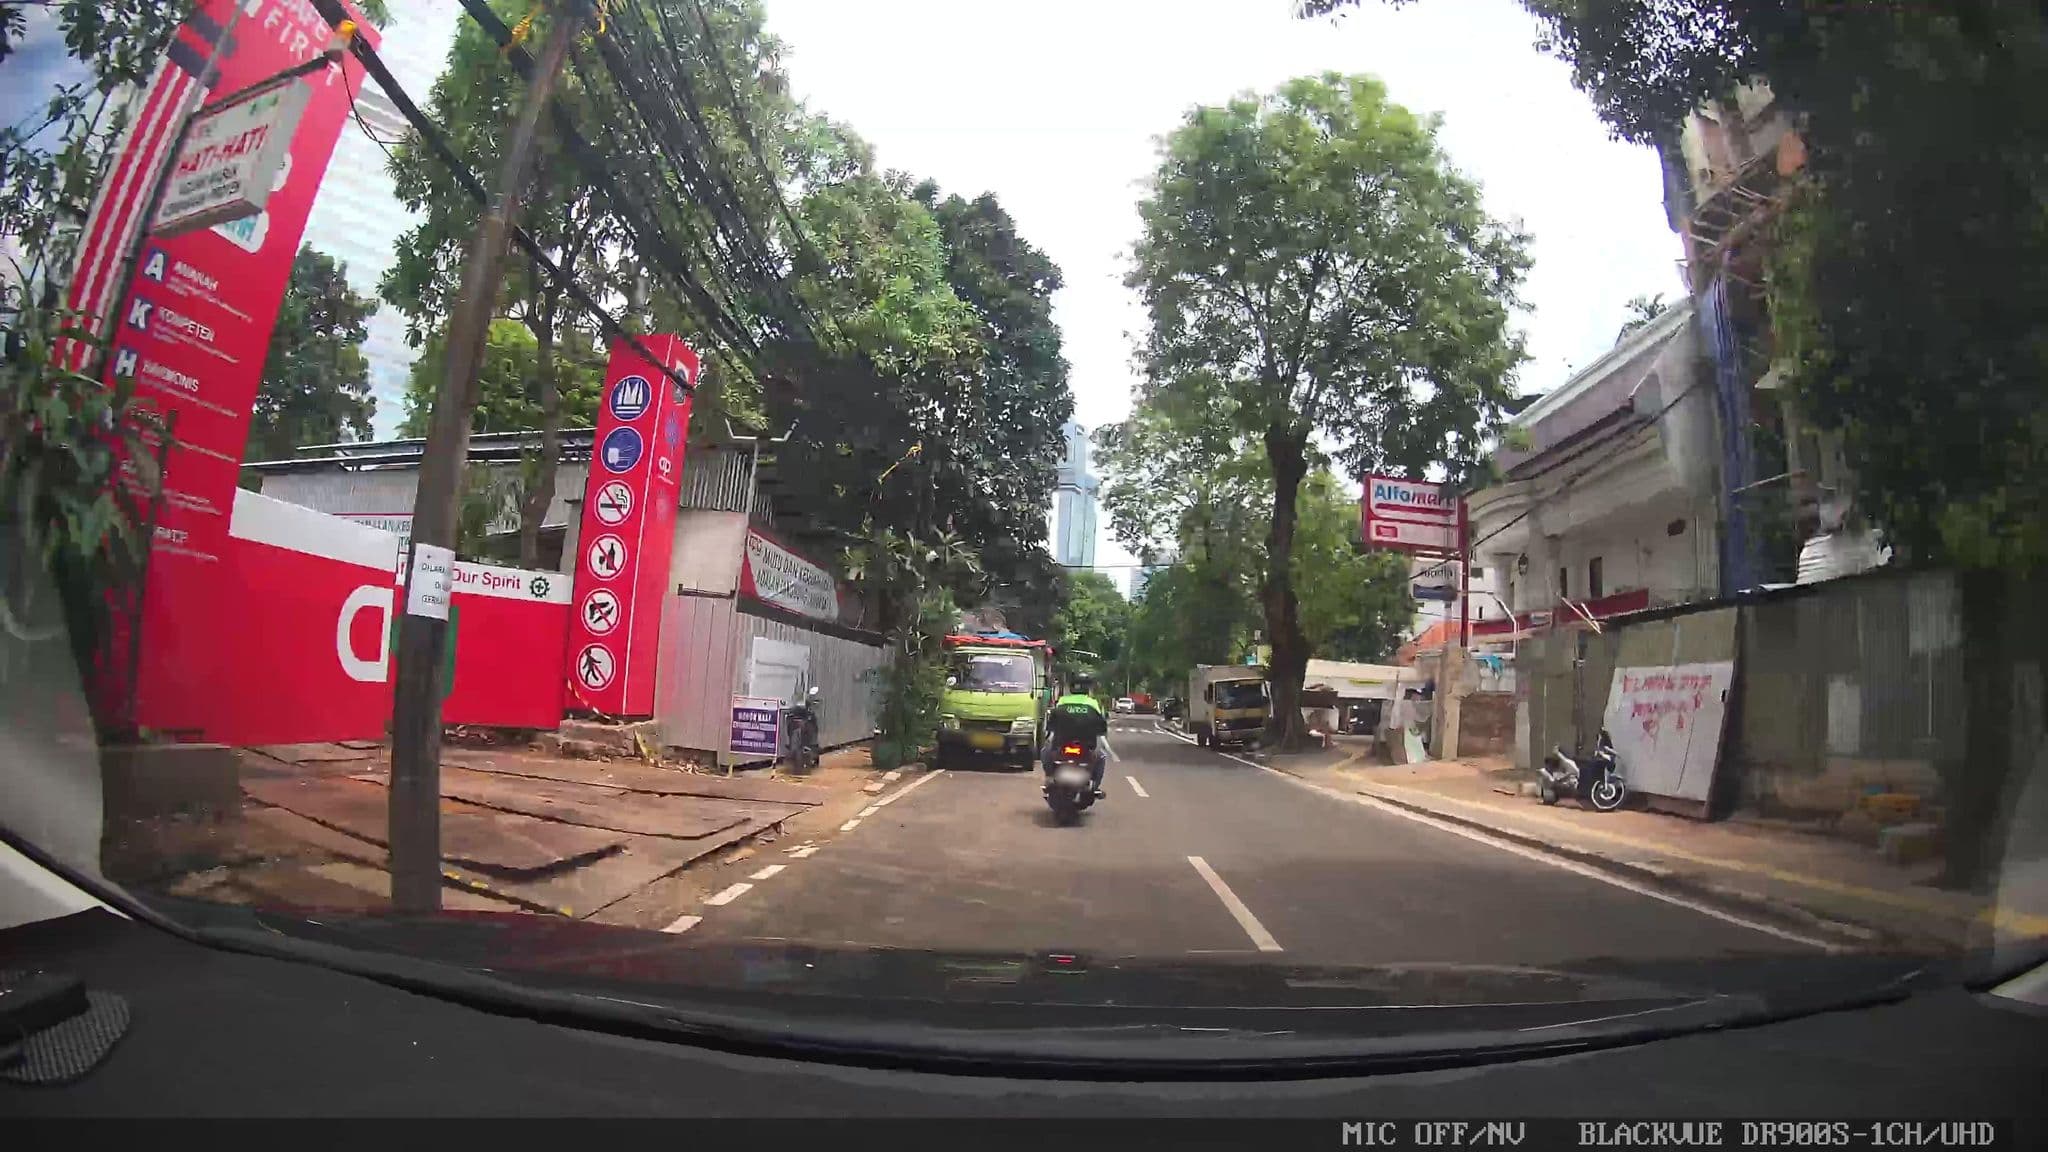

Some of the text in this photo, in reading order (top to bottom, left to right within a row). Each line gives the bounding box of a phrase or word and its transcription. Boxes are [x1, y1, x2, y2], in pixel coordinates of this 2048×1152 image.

[144, 253, 164, 281] A
[129, 299, 152, 329] K
[115, 350, 137, 377] H
[482, 572, 521, 590] Spirit
